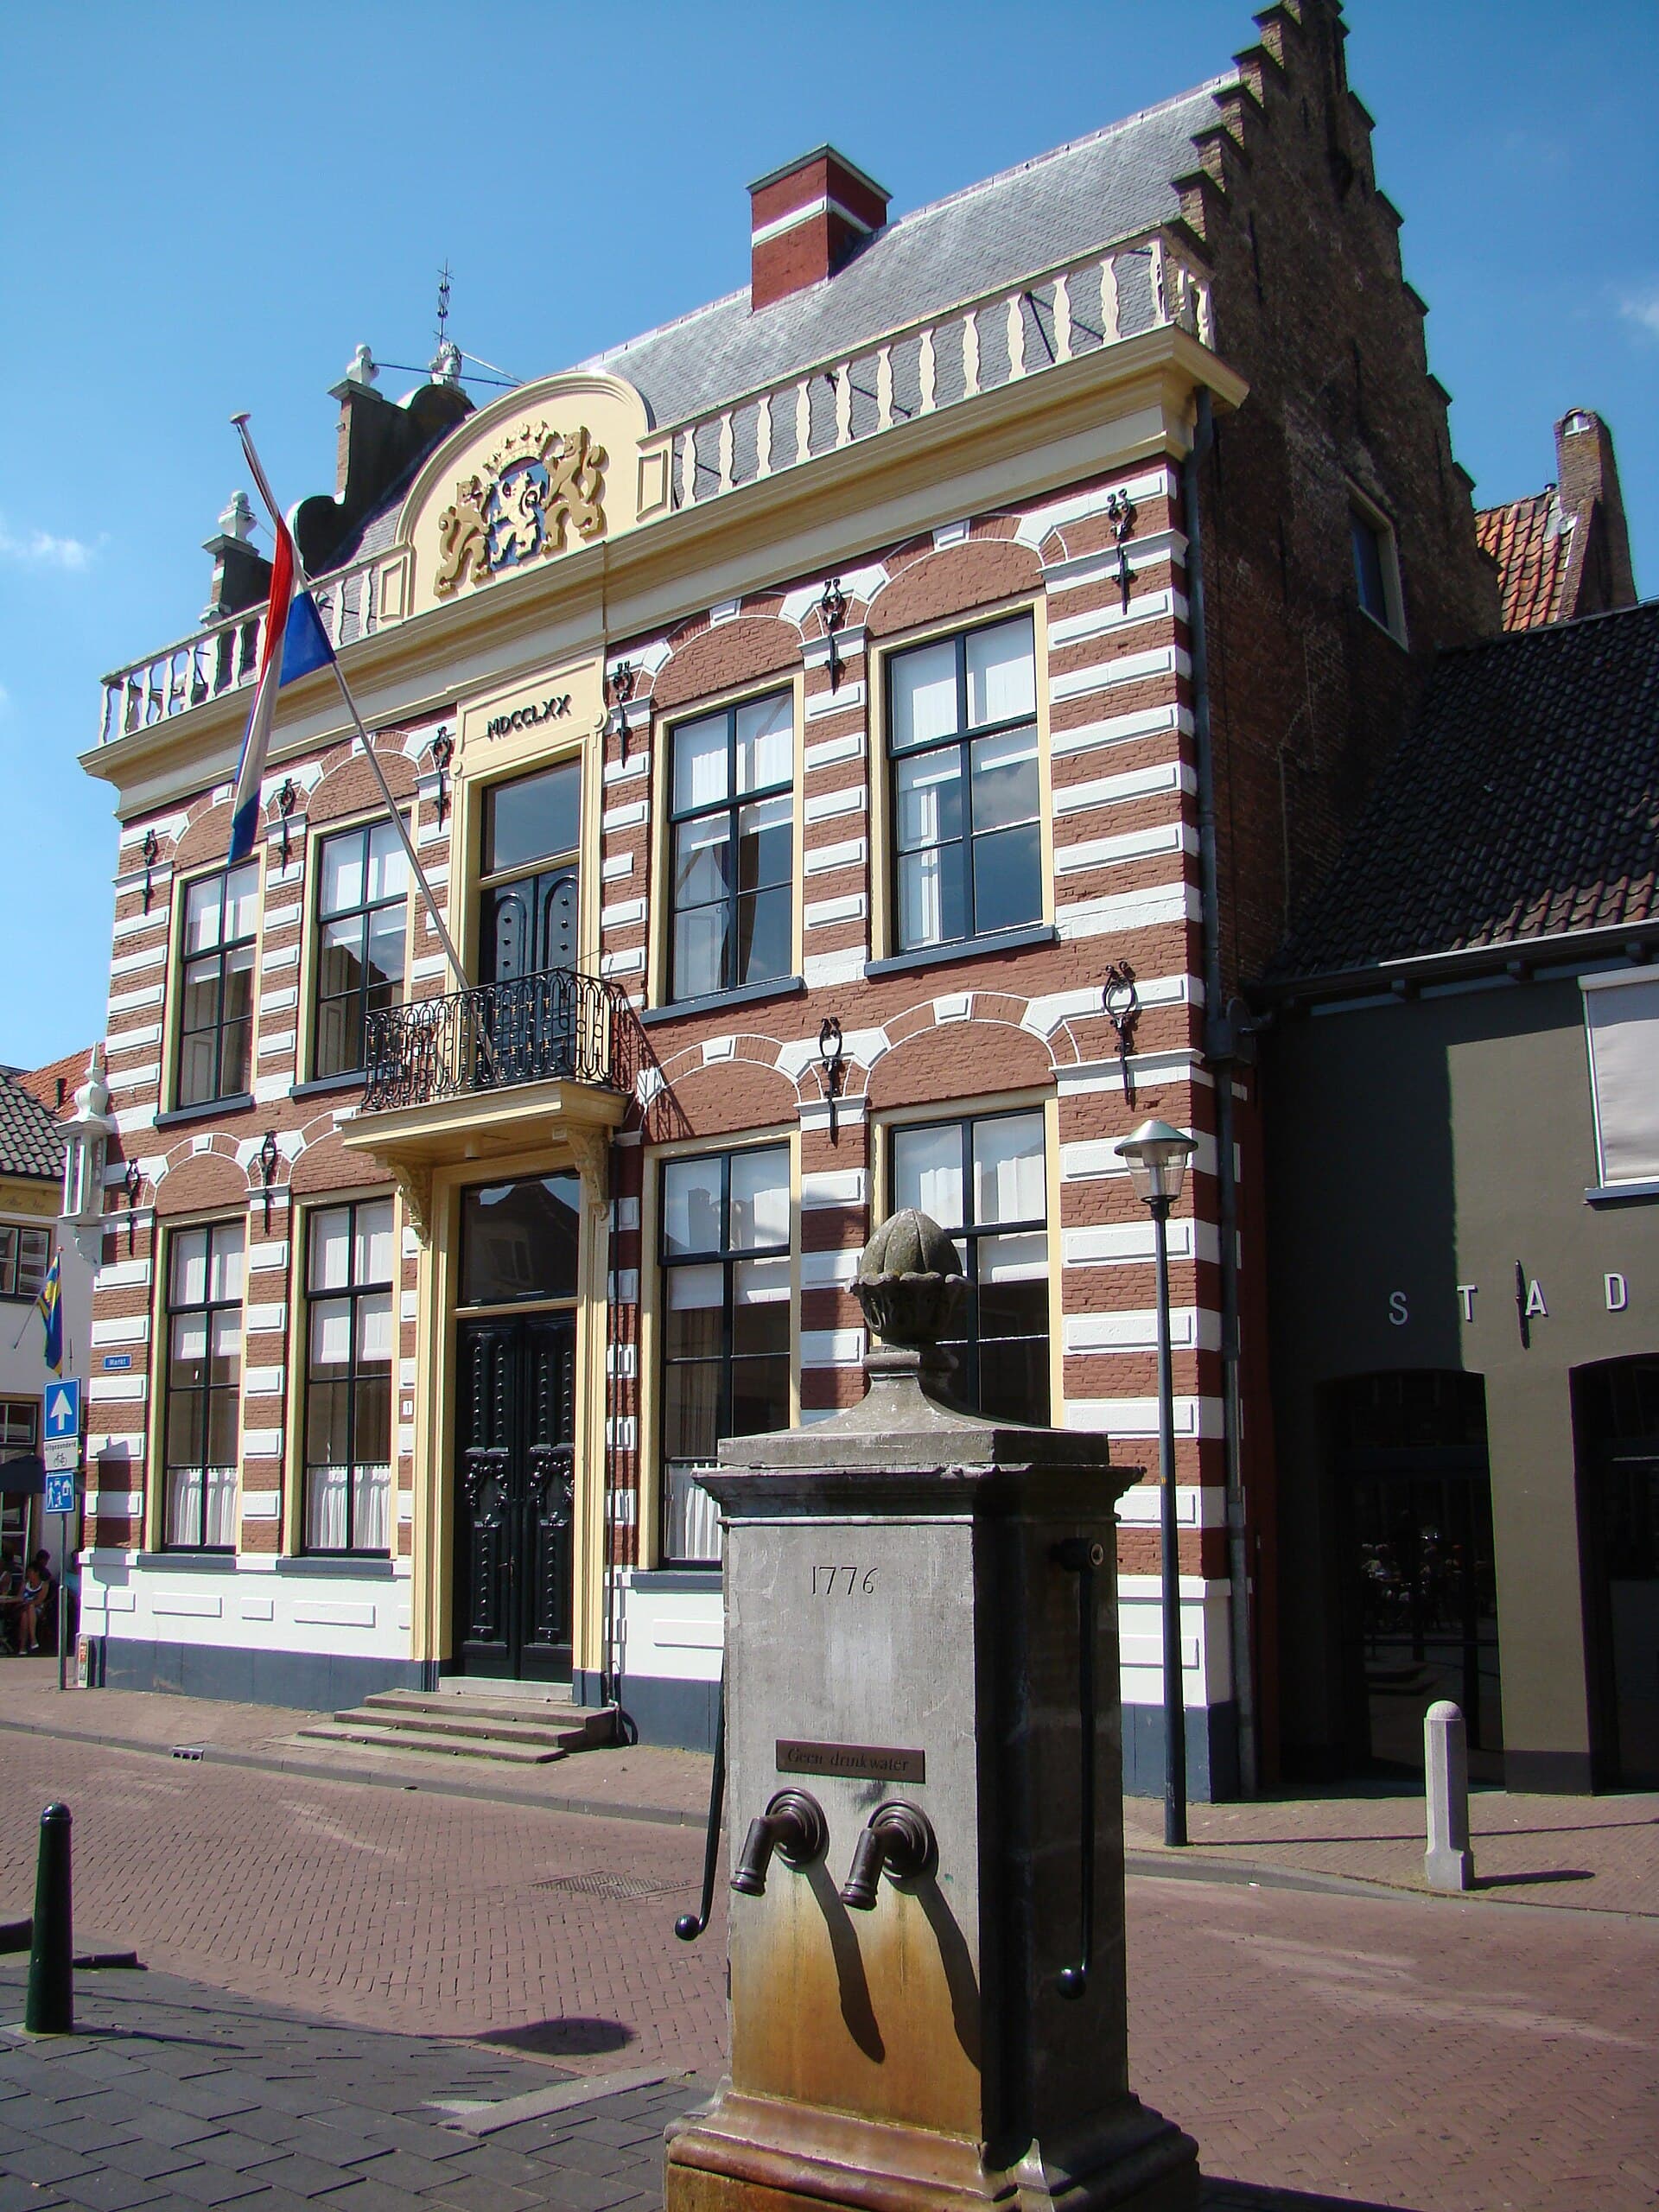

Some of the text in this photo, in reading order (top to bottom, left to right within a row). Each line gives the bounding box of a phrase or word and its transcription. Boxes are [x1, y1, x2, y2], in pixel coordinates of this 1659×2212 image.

[486, 694, 572, 742] MDCCLXX
[109, 1357, 127, 1366] Markt
[812, 1566, 879, 1595] 1776
[787, 1747, 822, 1765] Geen
